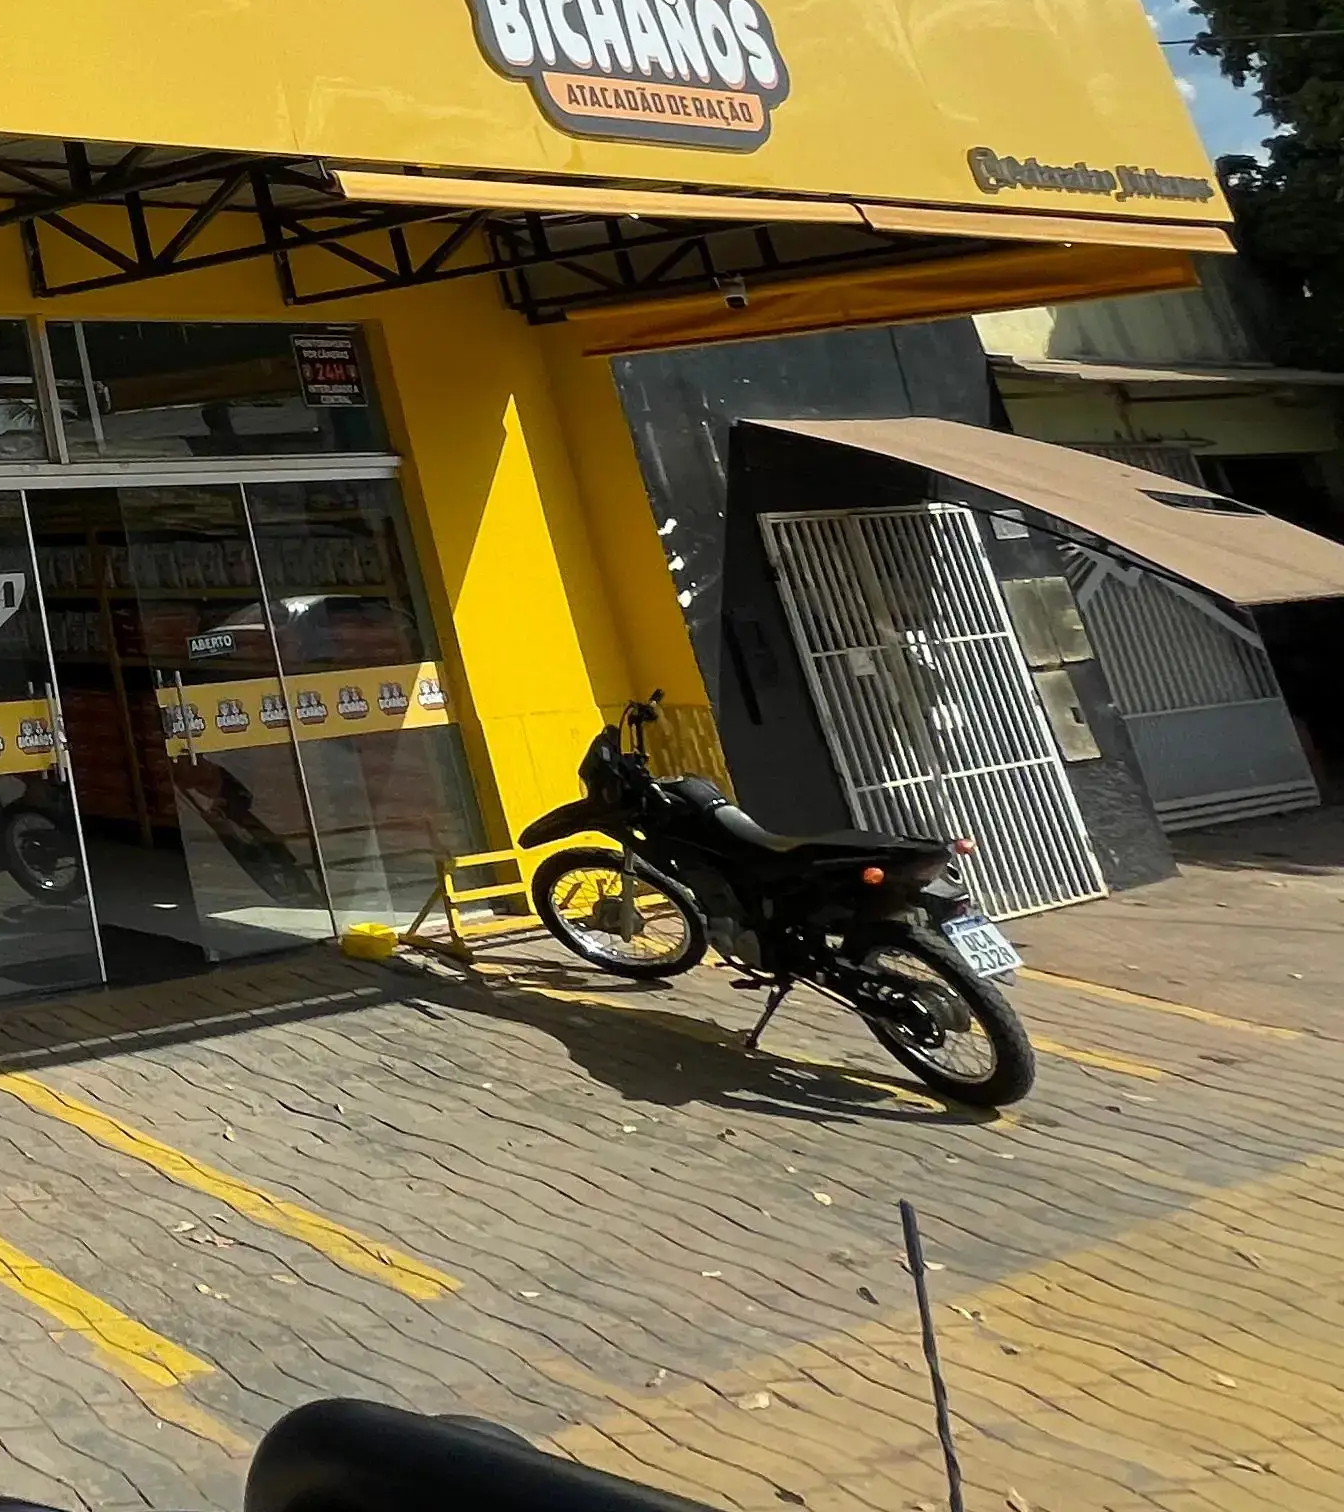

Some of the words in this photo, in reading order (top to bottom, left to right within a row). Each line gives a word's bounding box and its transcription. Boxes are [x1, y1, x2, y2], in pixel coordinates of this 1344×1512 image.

[565, 82, 663, 115] ATACADÃO
[668, 93, 690, 118] DE
[695, 95, 754, 127] RAÇÃO
[191, 634, 232, 652] ABERTO
